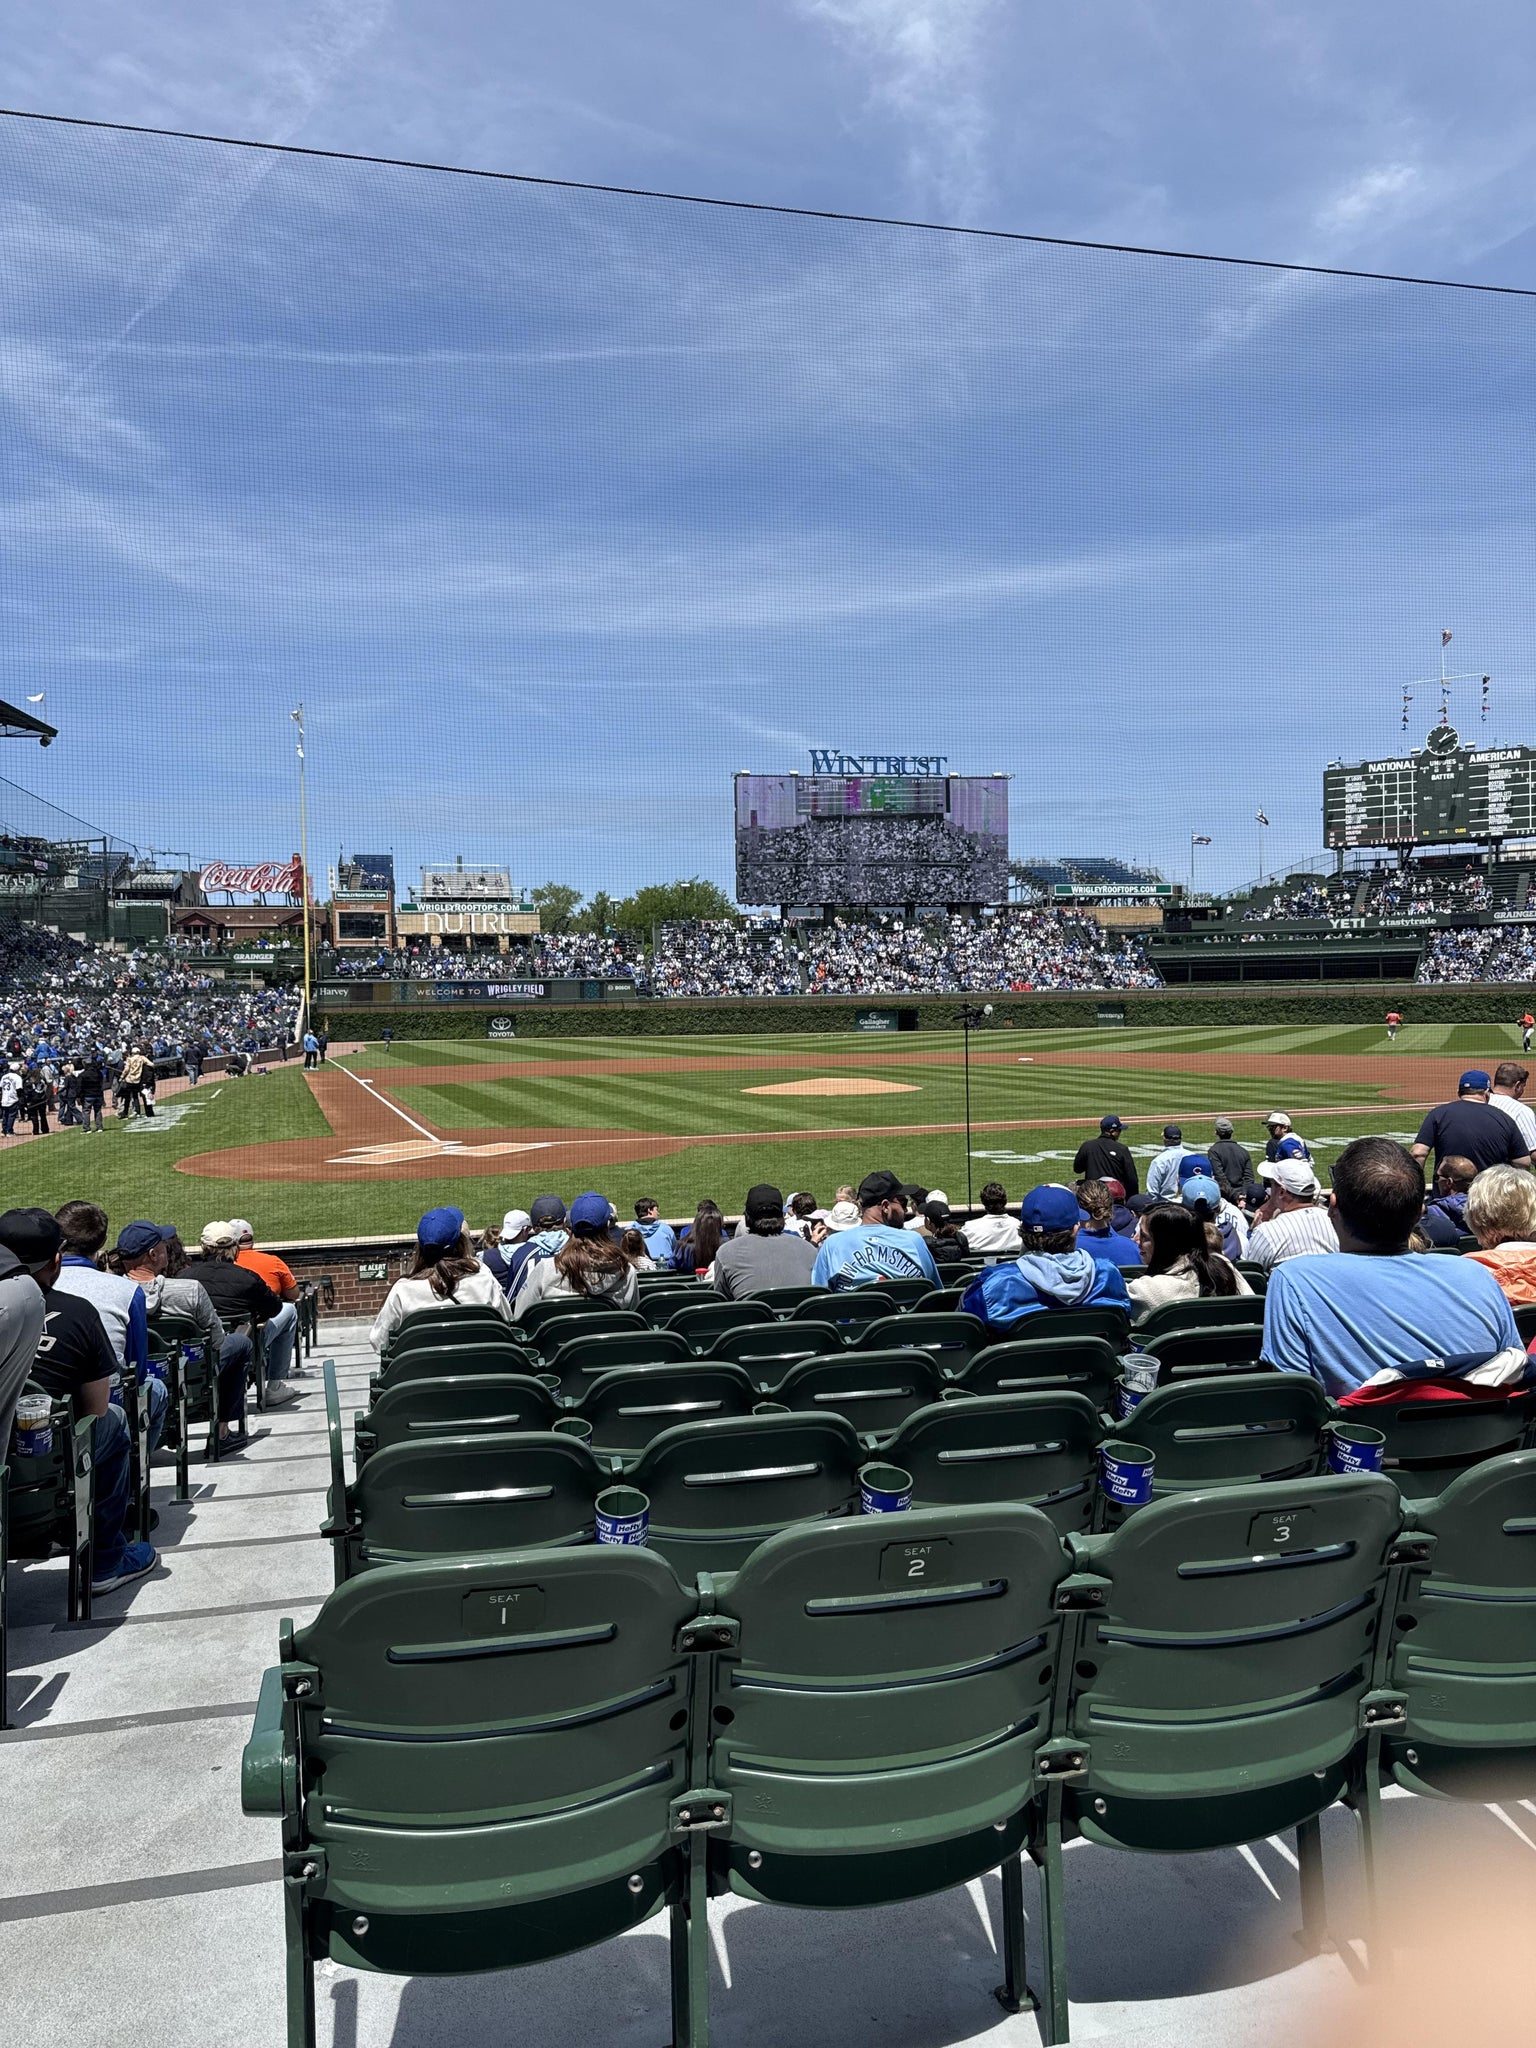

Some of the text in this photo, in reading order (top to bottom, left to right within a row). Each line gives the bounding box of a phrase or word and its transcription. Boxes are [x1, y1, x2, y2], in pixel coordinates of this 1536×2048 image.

[1469, 750, 1521, 764] AMERICAN
[808, 750, 948, 776] WINTRUST
[1368, 760, 1418, 773] NATIONAL
[200, 861, 298, 894] Coca-Cola
[417, 903, 520, 912] WRIGLEYROOFTOPS.COM
[1187, 900, 1212, 908] Mobile
[1493, 911, 1536, 919] GRAINGE
[1329, 918, 1366, 929] YETI
[1386, 917, 1437, 927] tastytrade
[233, 953, 275, 961] GRAINGER
[319, 987, 349, 997] Harvey
[487, 984, 522, 996] WRIGLEY
[523, 984, 545, 996] FIELD
[1338, 1452, 1359, 1465] Hefty
[1107, 1471, 1126, 1484] Hefty
[1113, 1485, 1135, 1496] Hefty
[1272, 1514, 1298, 1524] SEAT
[618, 1521, 641, 1532] Hefty
[600, 1534, 622, 1544] Hefty
[1273, 1526, 1290, 1542] 3
[904, 1546, 932, 1556] SEAT
[907, 1559, 925, 1577] 2
[488, 1593, 520, 1604] SEAT
[501, 1607, 507, 1625] 1
